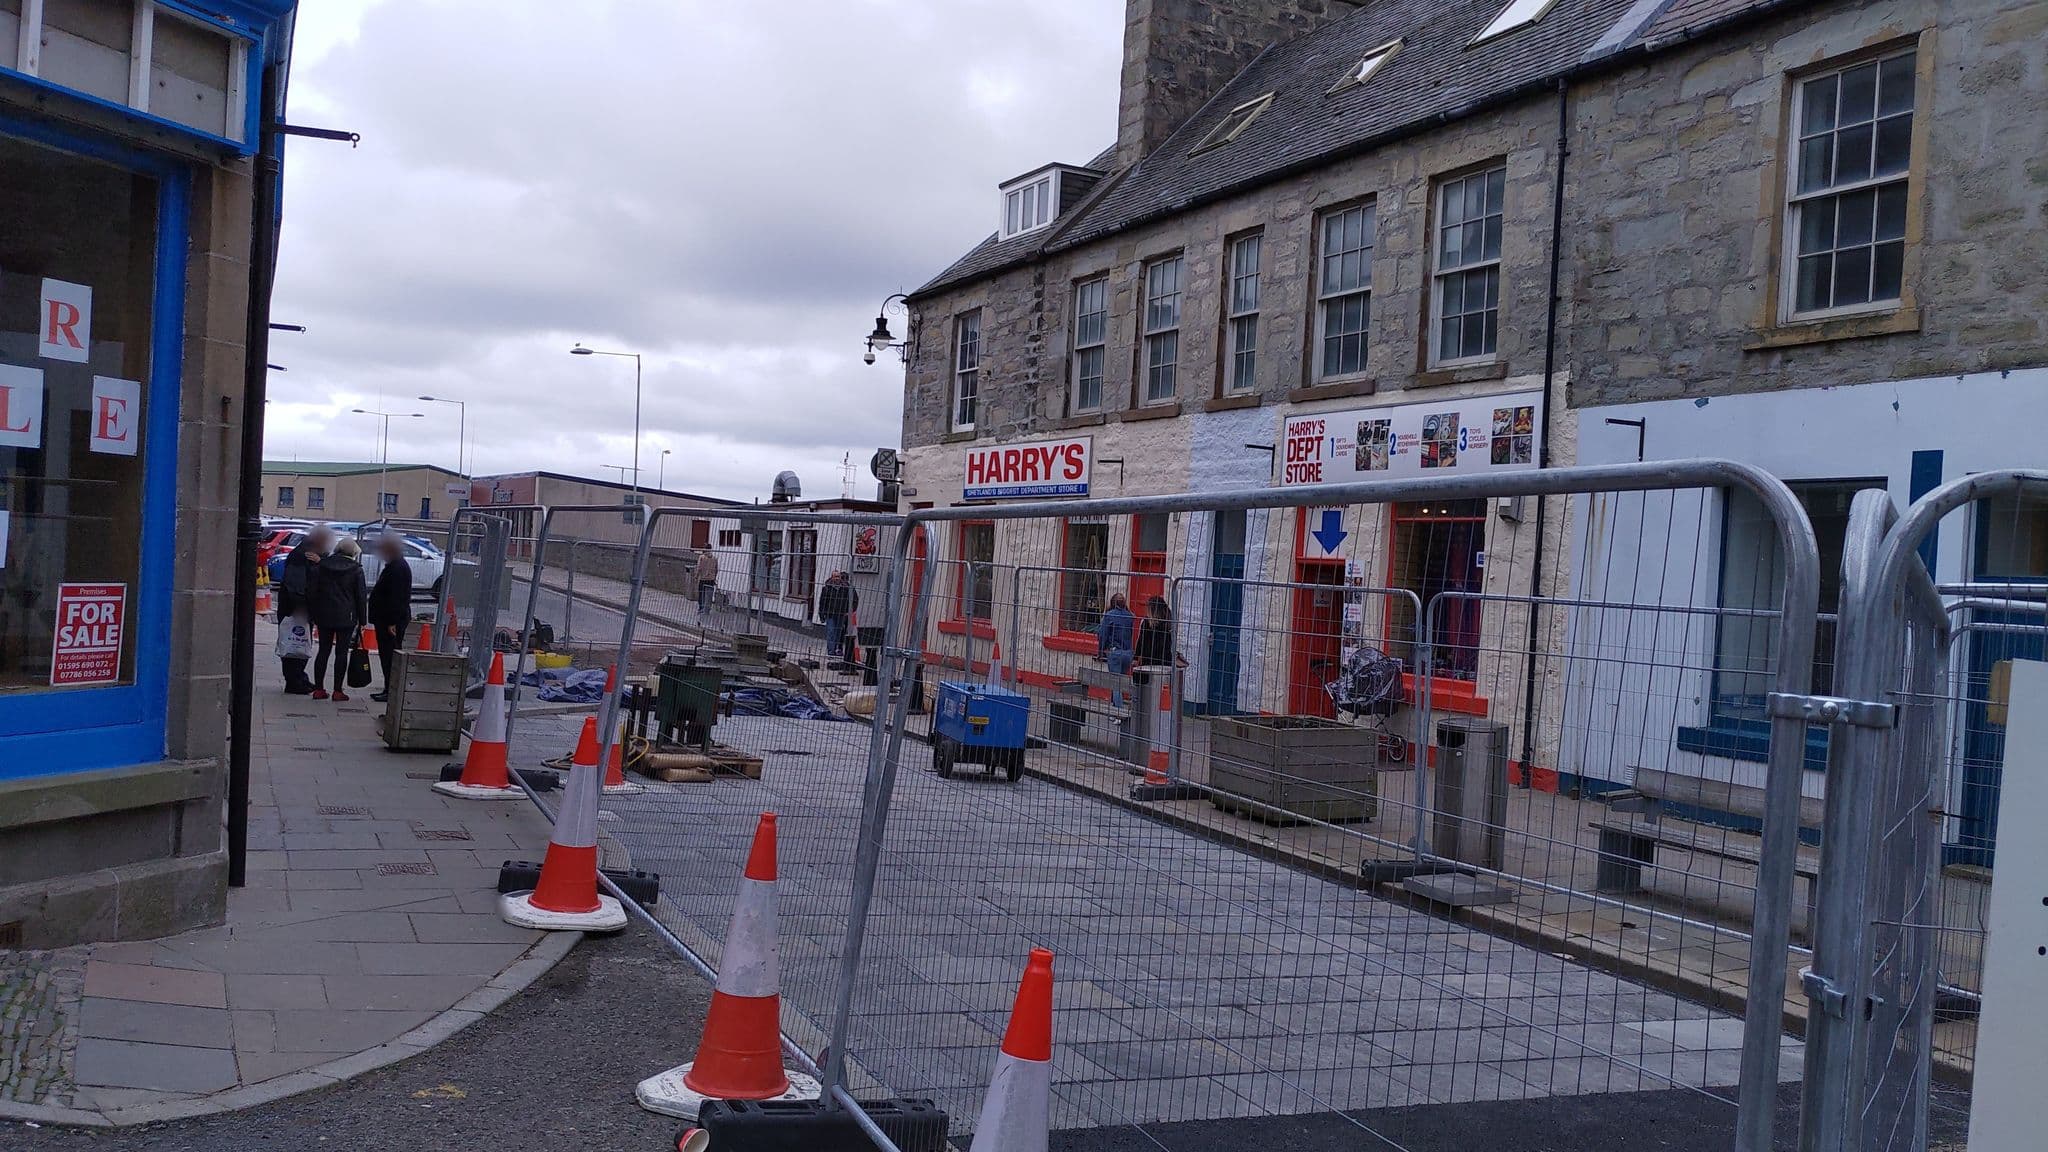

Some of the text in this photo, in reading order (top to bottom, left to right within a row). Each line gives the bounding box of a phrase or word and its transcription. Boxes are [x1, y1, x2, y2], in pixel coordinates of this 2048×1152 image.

[44, 299, 84, 349] R
[1288, 419, 1326, 437] HARRY'S
[1459, 427, 1467, 451] 3
[1287, 436, 1324, 462] DEPT
[1330, 437, 1335, 458] 1
[1389, 432, 1397, 455] 2
[967, 443, 1085, 485] HARRY'S
[1285, 462, 1323, 483] STORE
[1020, 485, 1057, 495] DEPARTMENT
[1058, 484, 1078, 493] STORE
[66, 602, 115, 624] FOR
[59, 624, 119, 647] SALE
[58, 662, 80, 670] 01595
[95, 660, 109, 668] 072
[60, 671, 83, 679] 07786
